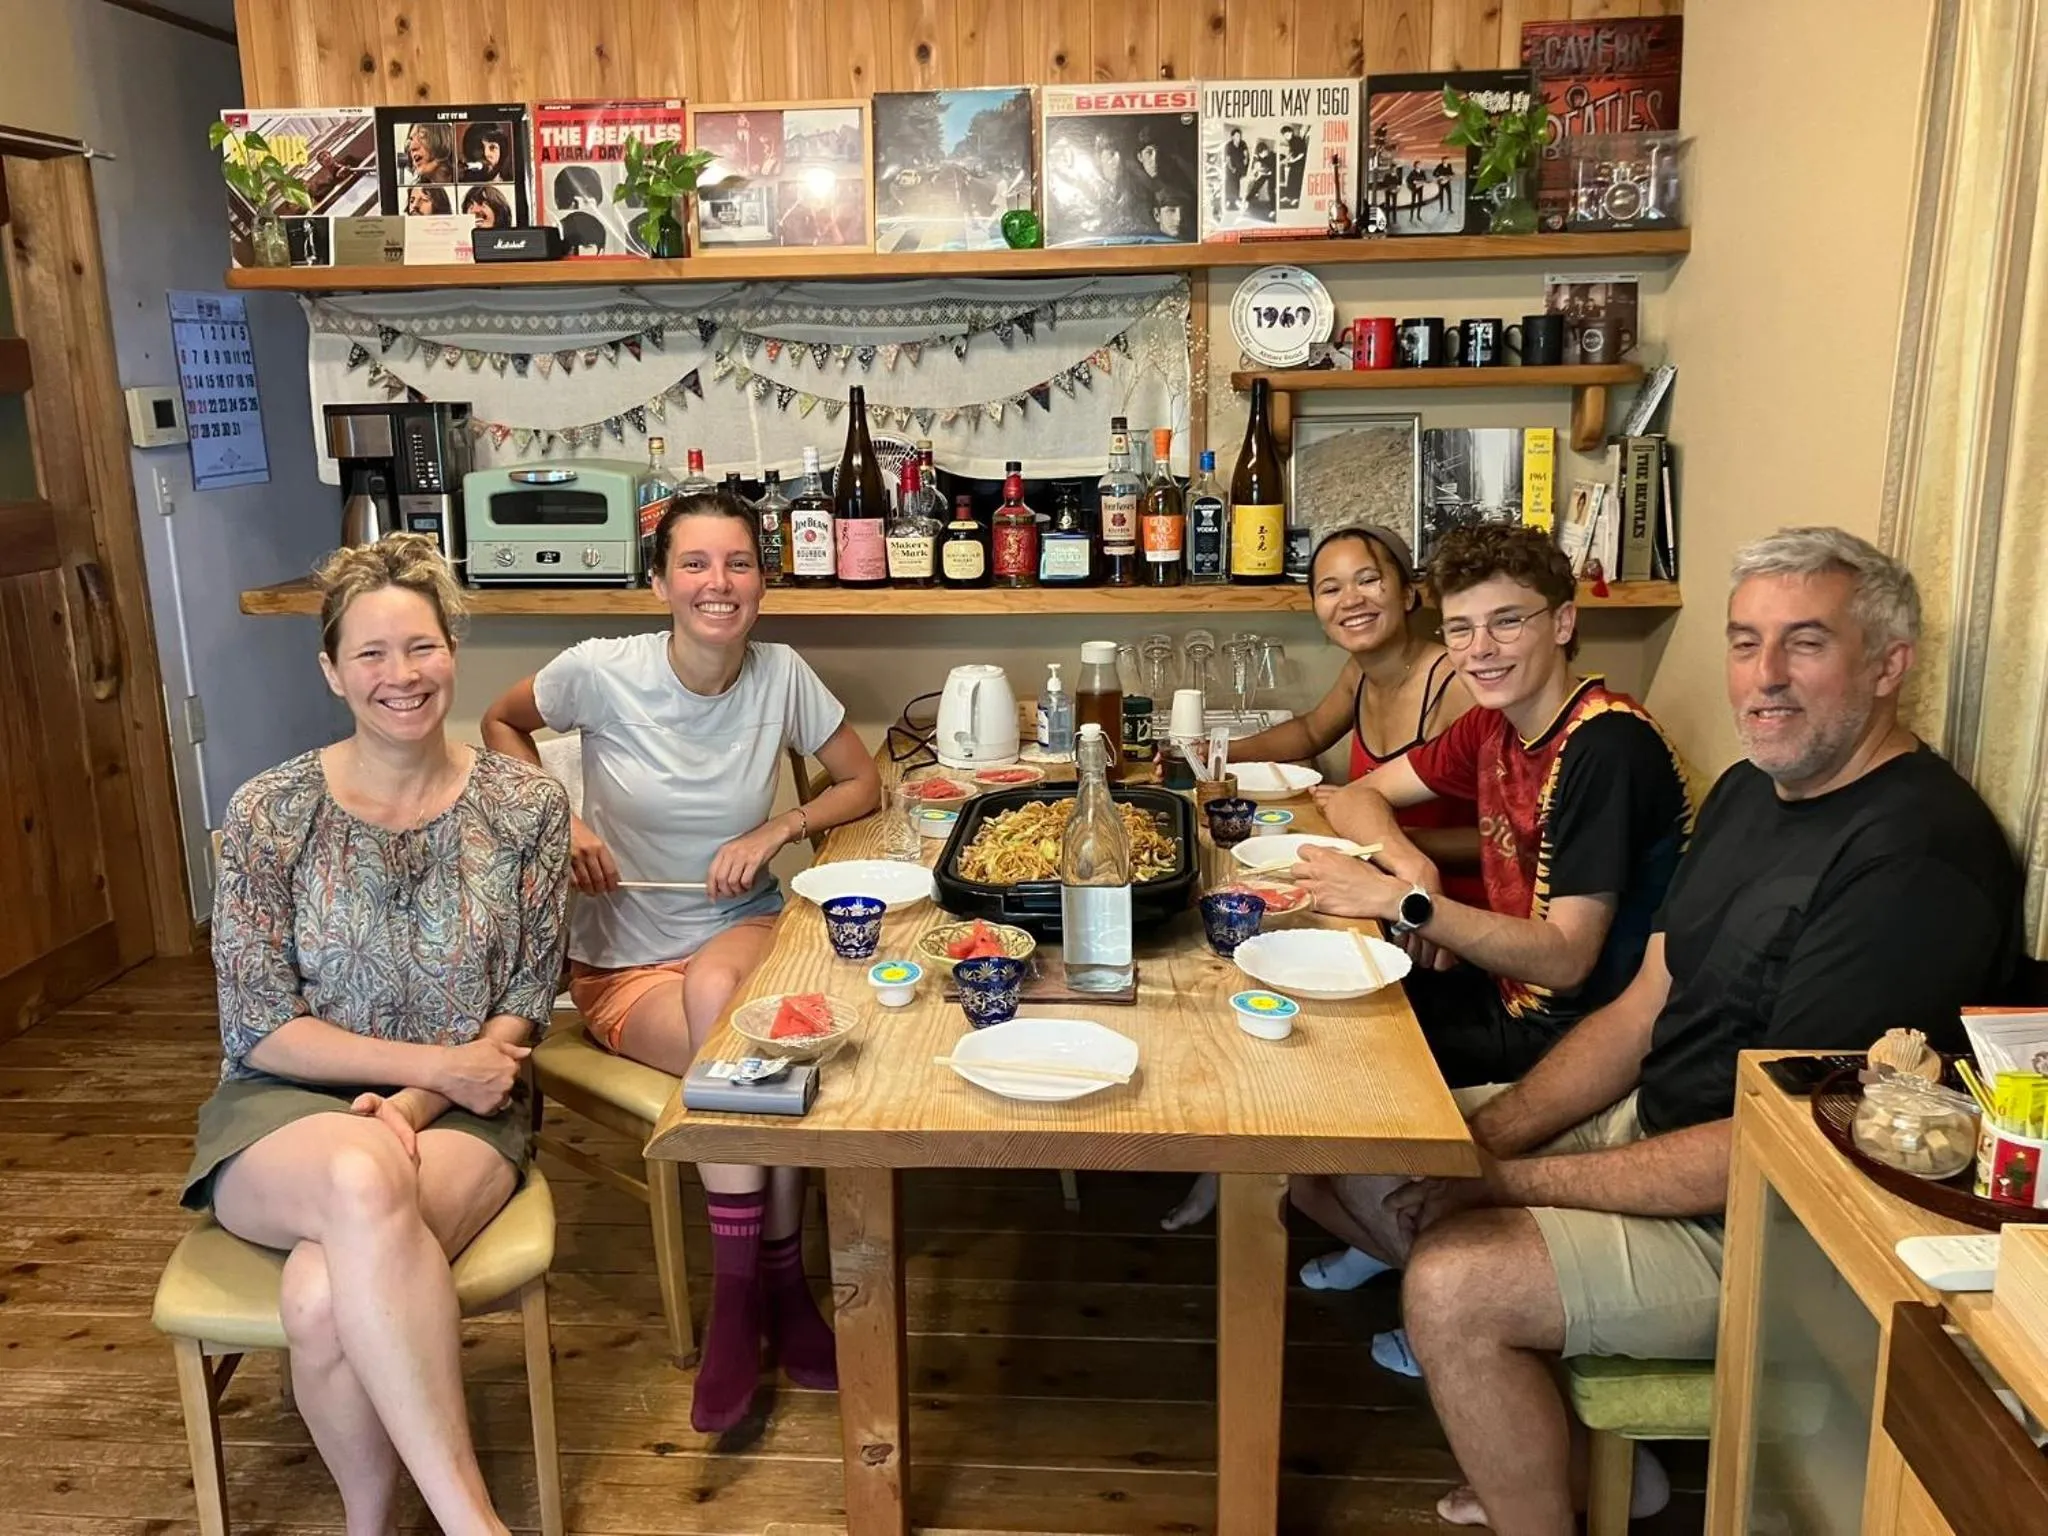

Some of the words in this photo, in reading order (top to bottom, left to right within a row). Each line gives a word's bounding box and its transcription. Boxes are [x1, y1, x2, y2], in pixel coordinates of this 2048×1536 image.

[1076, 92, 1197, 110] BEATLES!
[1204, 89, 1275, 119] LIVERPOOL
[1281, 88, 1311, 117] MAY
[1317, 87, 1349, 116] 1960
[437, 112, 450, 120] LET
[458, 111, 468, 119] BE
[540, 126, 582, 147] THE
[588, 123, 682, 147] BEATLES
[542, 147, 551, 161] A
[556, 147, 593, 161] HARD
[203, 349, 210, 364] 8
[223, 350, 231, 364] 10
[233, 350, 241, 364] 11
[241, 350, 252, 364] 12
[1636, 453, 1649, 480] THE
[1632, 483, 1648, 538] BEATLES
[794, 520, 806, 534] JIM
[807, 516, 829, 532] BEAM
[1196, 526, 1219, 534] VODKA
[890, 541, 929, 549] Maker's
[901, 548, 928, 557] Mark
